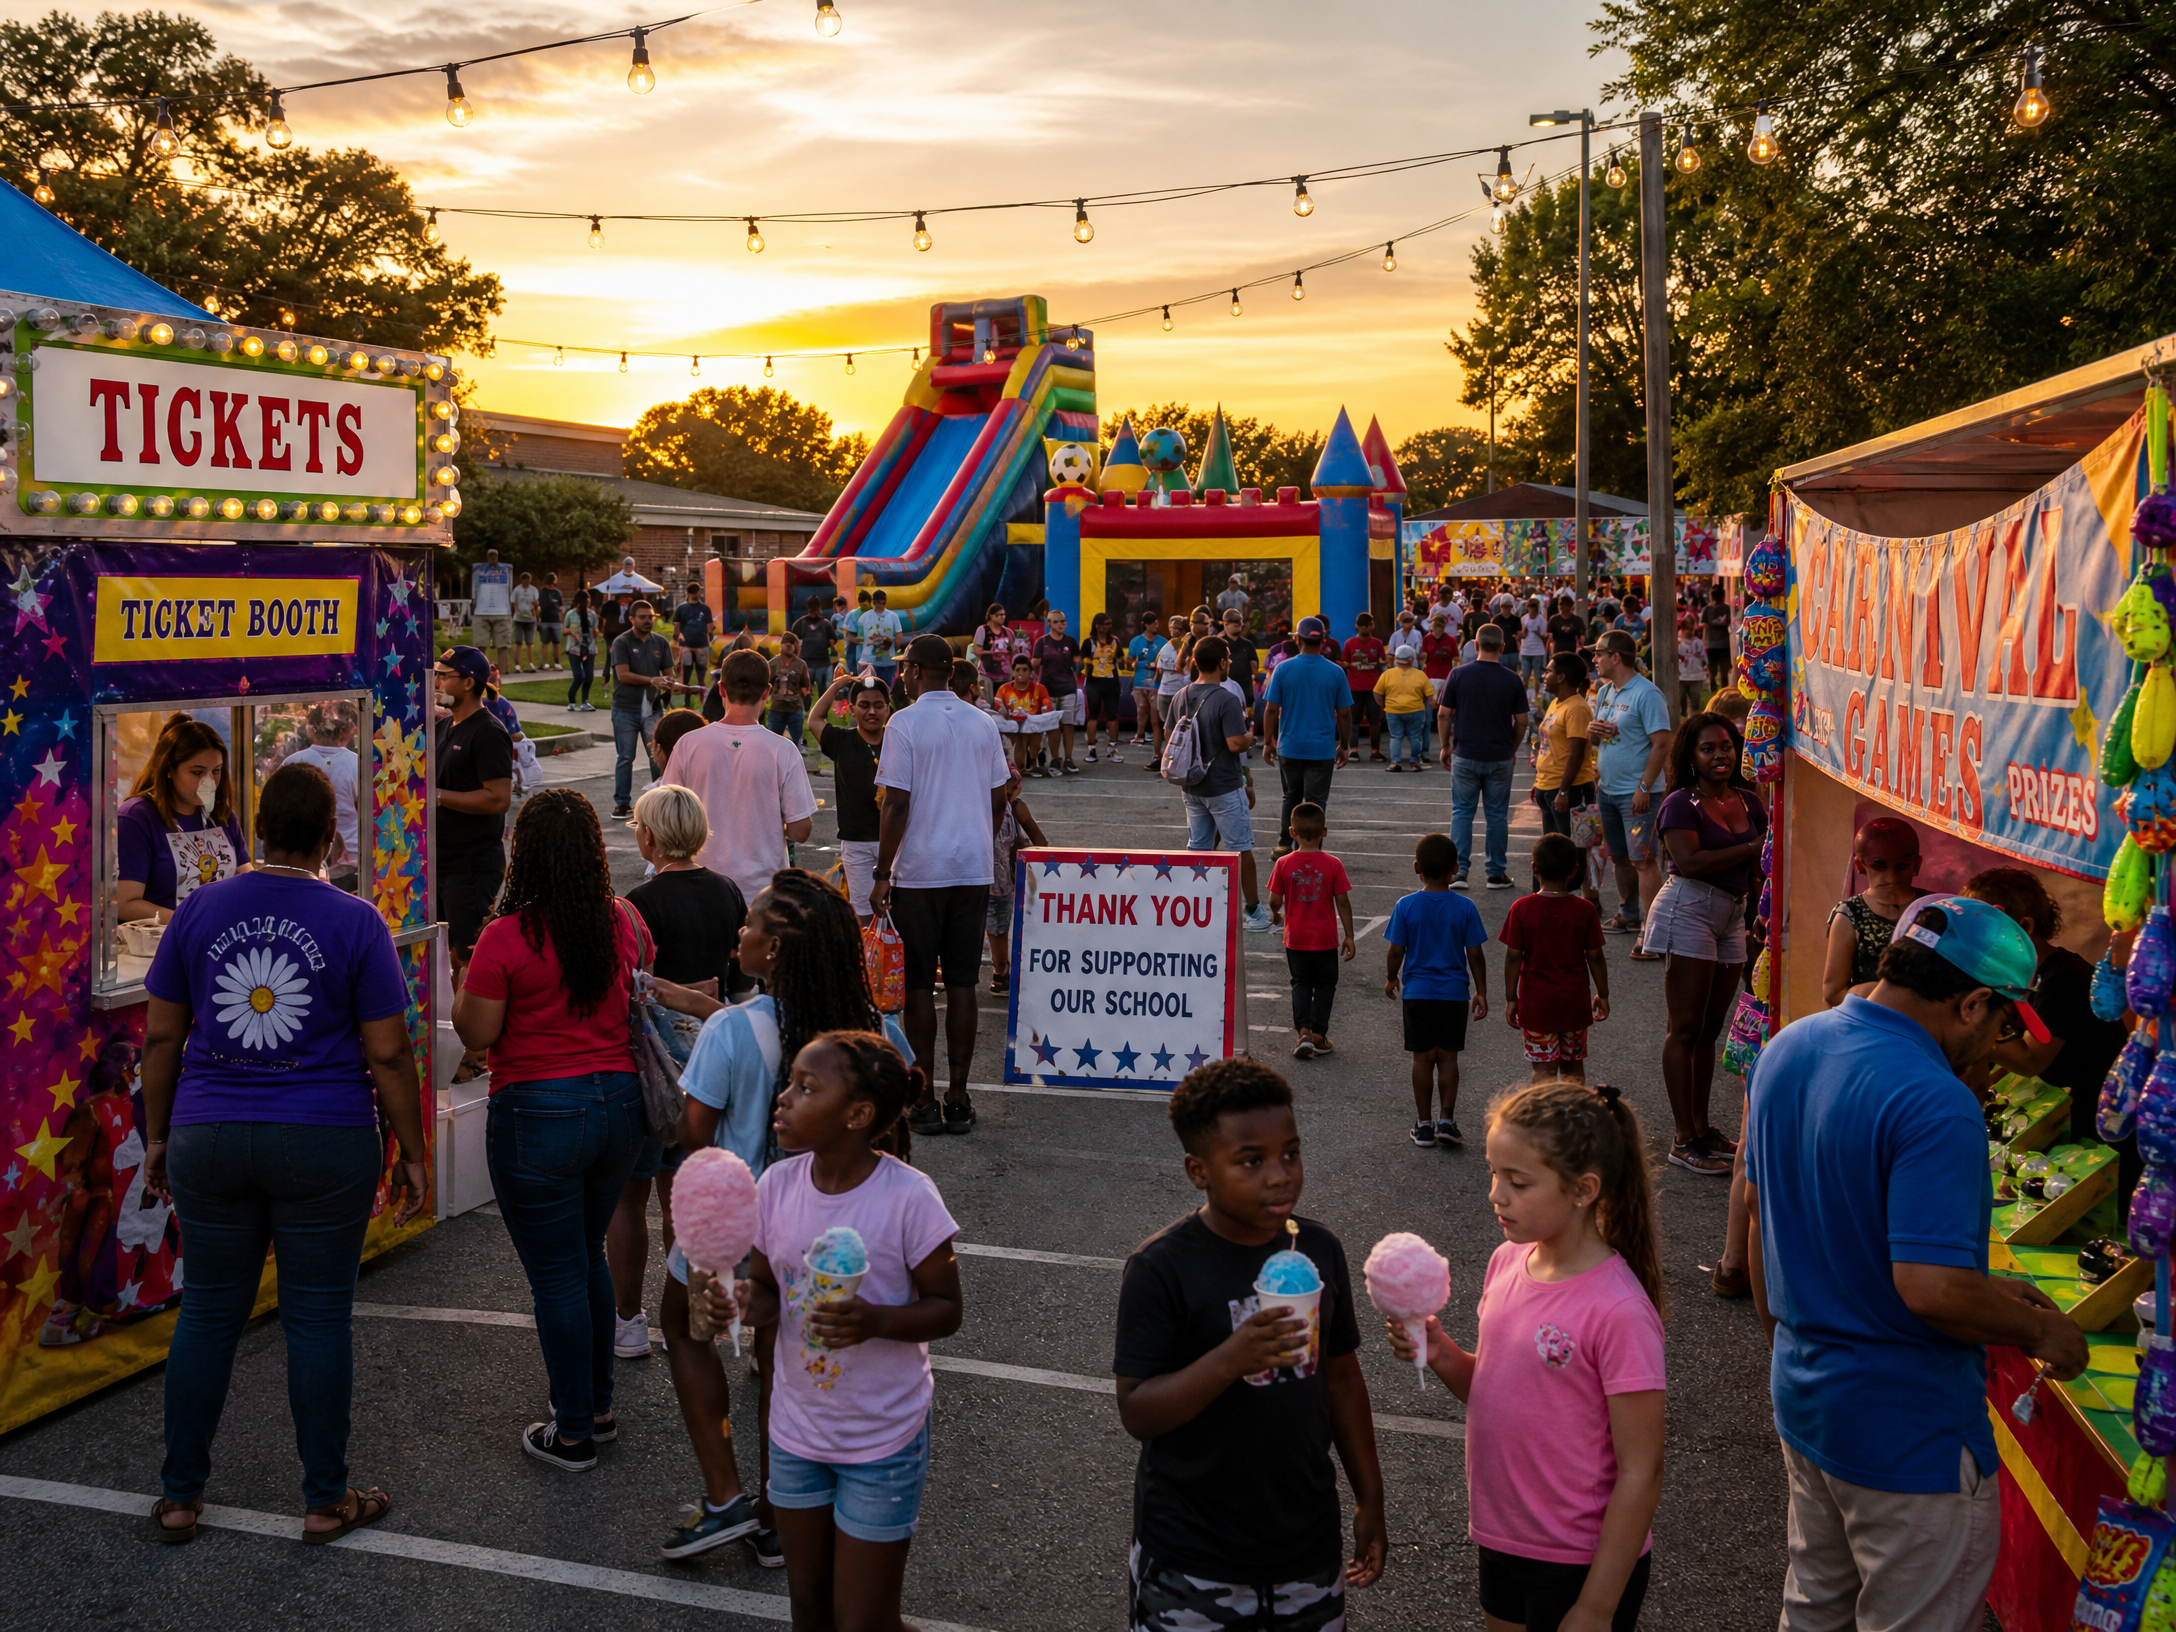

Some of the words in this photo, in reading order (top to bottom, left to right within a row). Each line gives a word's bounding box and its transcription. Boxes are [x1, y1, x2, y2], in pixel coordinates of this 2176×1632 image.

[90, 378, 364, 476] TICKETS
[120, 598, 237, 641] TICKET
[246, 597, 341, 638] BOOTH
[1801, 507, 2079, 706] CARNIVAL
[1844, 690, 1984, 833] GAMES
[2007, 763, 2098, 840] PRIZES
[1038, 892, 1138, 926] THANK
[1150, 895, 1213, 928] YOU
[1029, 948, 1071, 974] FOR
[1081, 950, 1218, 979] SUPPORTING
[1050, 988, 1096, 1014] OUR
[1105, 990, 1193, 1018] SCHOOL
